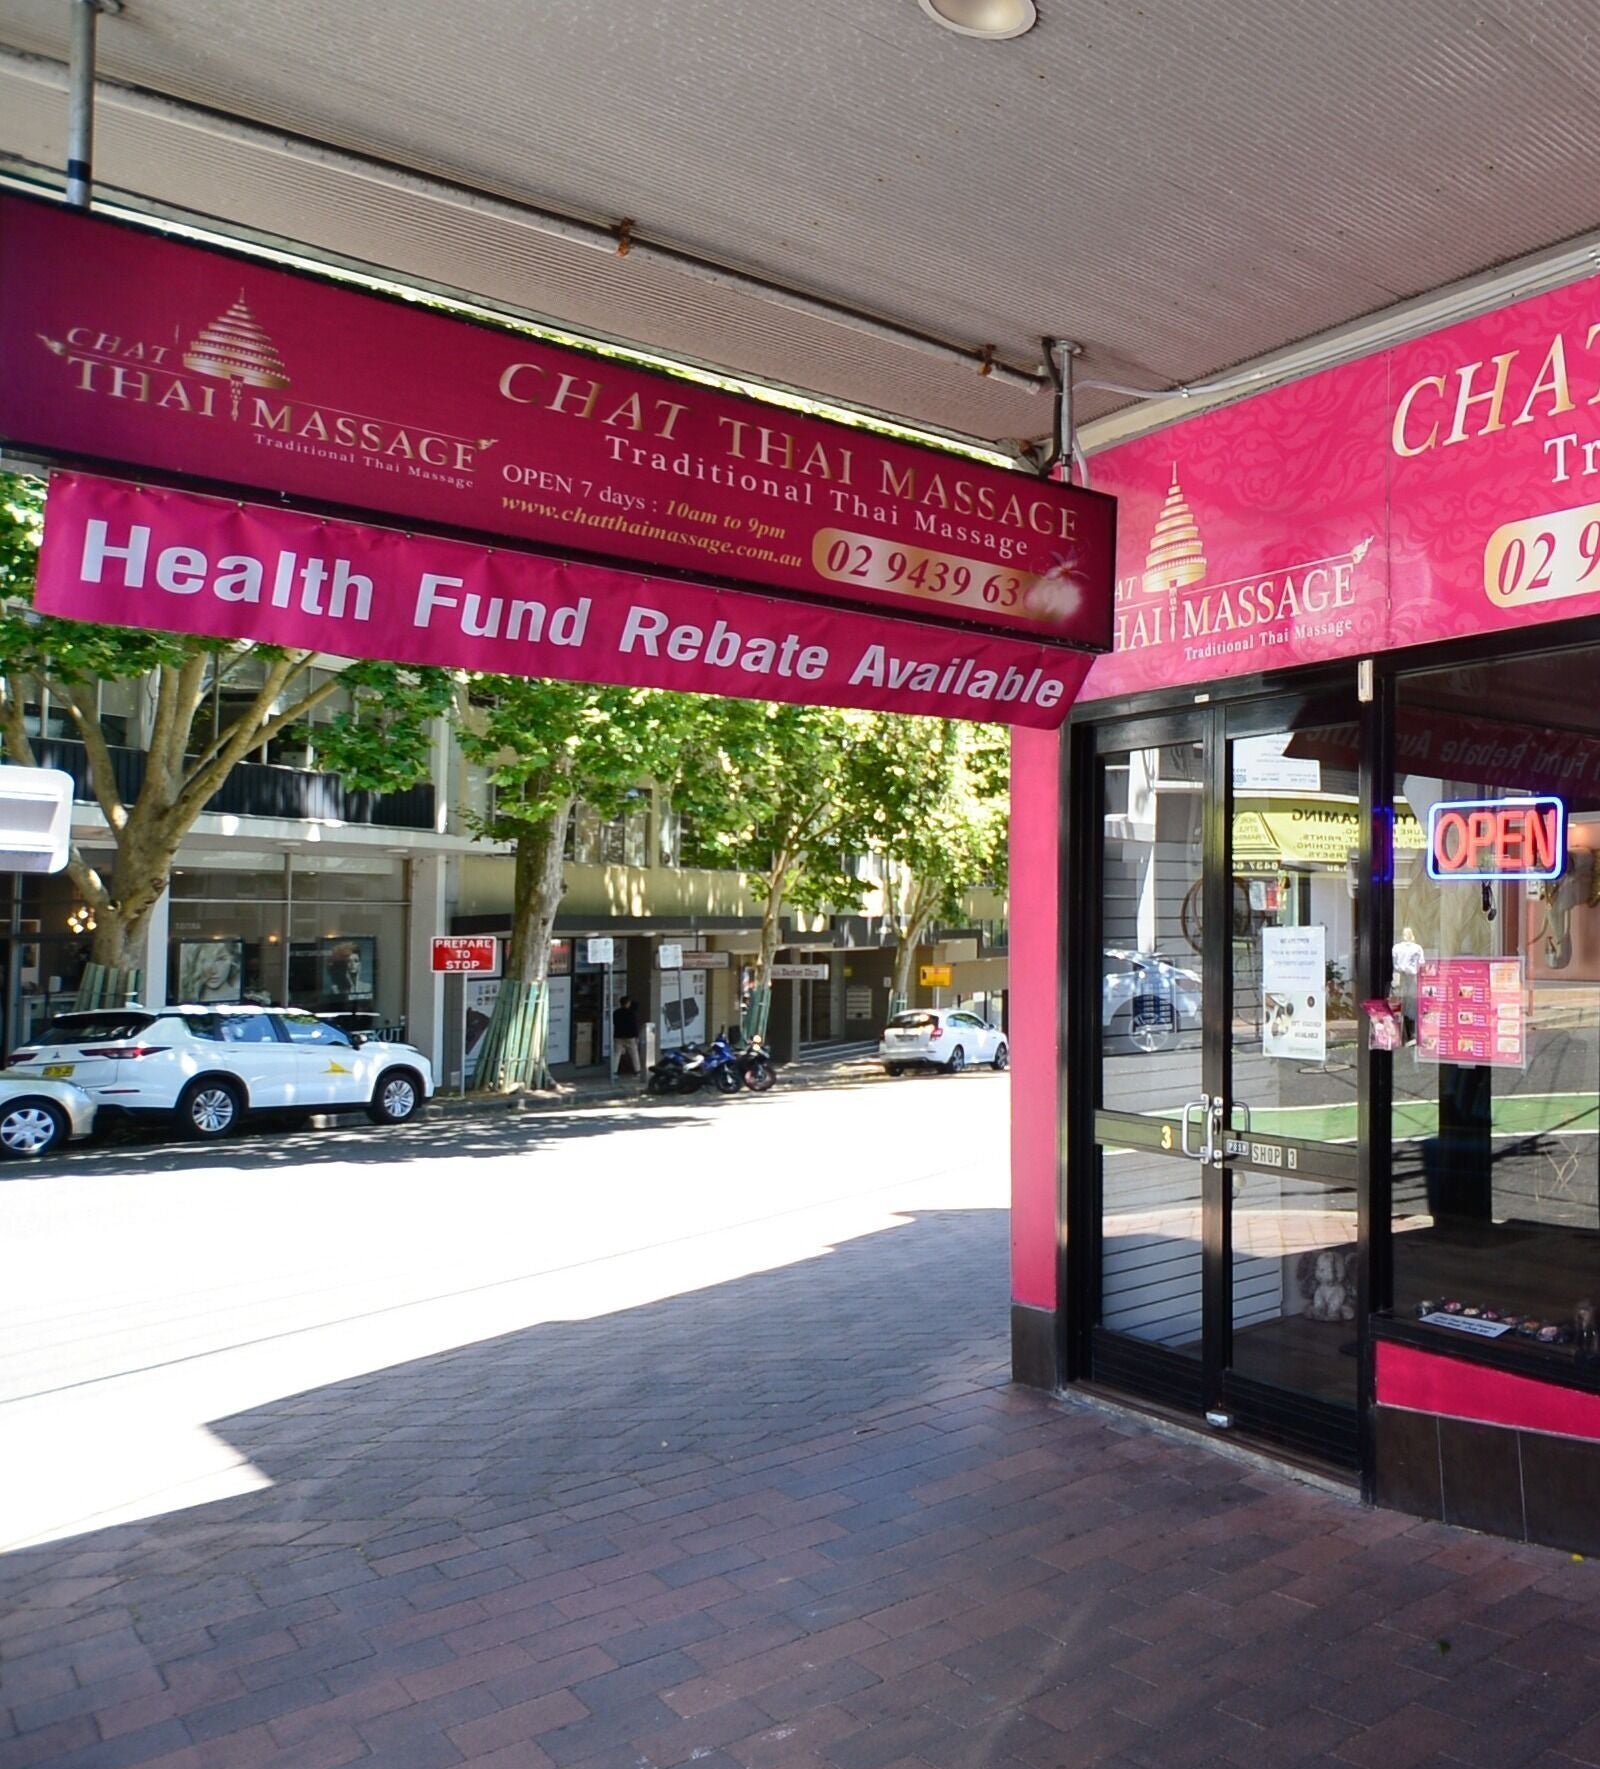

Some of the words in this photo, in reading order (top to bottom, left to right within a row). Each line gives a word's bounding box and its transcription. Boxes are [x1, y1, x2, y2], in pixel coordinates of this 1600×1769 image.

[67, 327, 169, 365] CHAT
[67, 356, 215, 418] THAI
[252, 397, 479, 473] MASSAGE
[253, 433, 356, 464] Traditional
[363, 456, 401, 474] Thai
[408, 465, 475, 490] Massage
[498, 363, 690, 440] CHAT
[718, 415, 854, 486] THAI
[880, 459, 1080, 542] MASSAGE
[502, 463, 574, 495] OPEN
[579, 478, 593, 498] 7
[599, 482, 647, 512] days
[665, 498, 719, 525] 10am
[723, 512, 743, 531] to
[747, 517, 787, 541] 9pm
[605, 436, 813, 505] Traditional
[830, 489, 900, 526] Thai
[914, 509, 1030, 558] Massage
[501, 495, 803, 569] www.chatthaimassage.com.au
[1498, 530, 1558, 595] 02
[826, 539, 872, 578] 02
[885, 550, 973, 599] 9439
[981, 573, 1021, 607] 63
[1115, 576, 1137, 602] AT
[80, 519, 373, 622] Health
[413, 573, 592, 648] Fund
[619, 605, 829, 681] Rebate
[848, 643, 1066, 709] Available
[1114, 607, 1163, 653] HAI
[1182, 564, 1357, 640] MASSAGE
[1184, 635, 1254, 662] Traditional
[1259, 627, 1289, 647] Thai
[1293, 616, 1352, 640] Massage
[1434, 808, 1557, 871] OPEN
[435, 939, 491, 949] PREPARE
[445, 960, 480, 970] STOP
[455, 949, 471, 959] TO
[1161, 1124, 1173, 1149] 3
[1253, 1145, 1281, 1164] SHOP
[1289, 1150, 1296, 1167] 3
